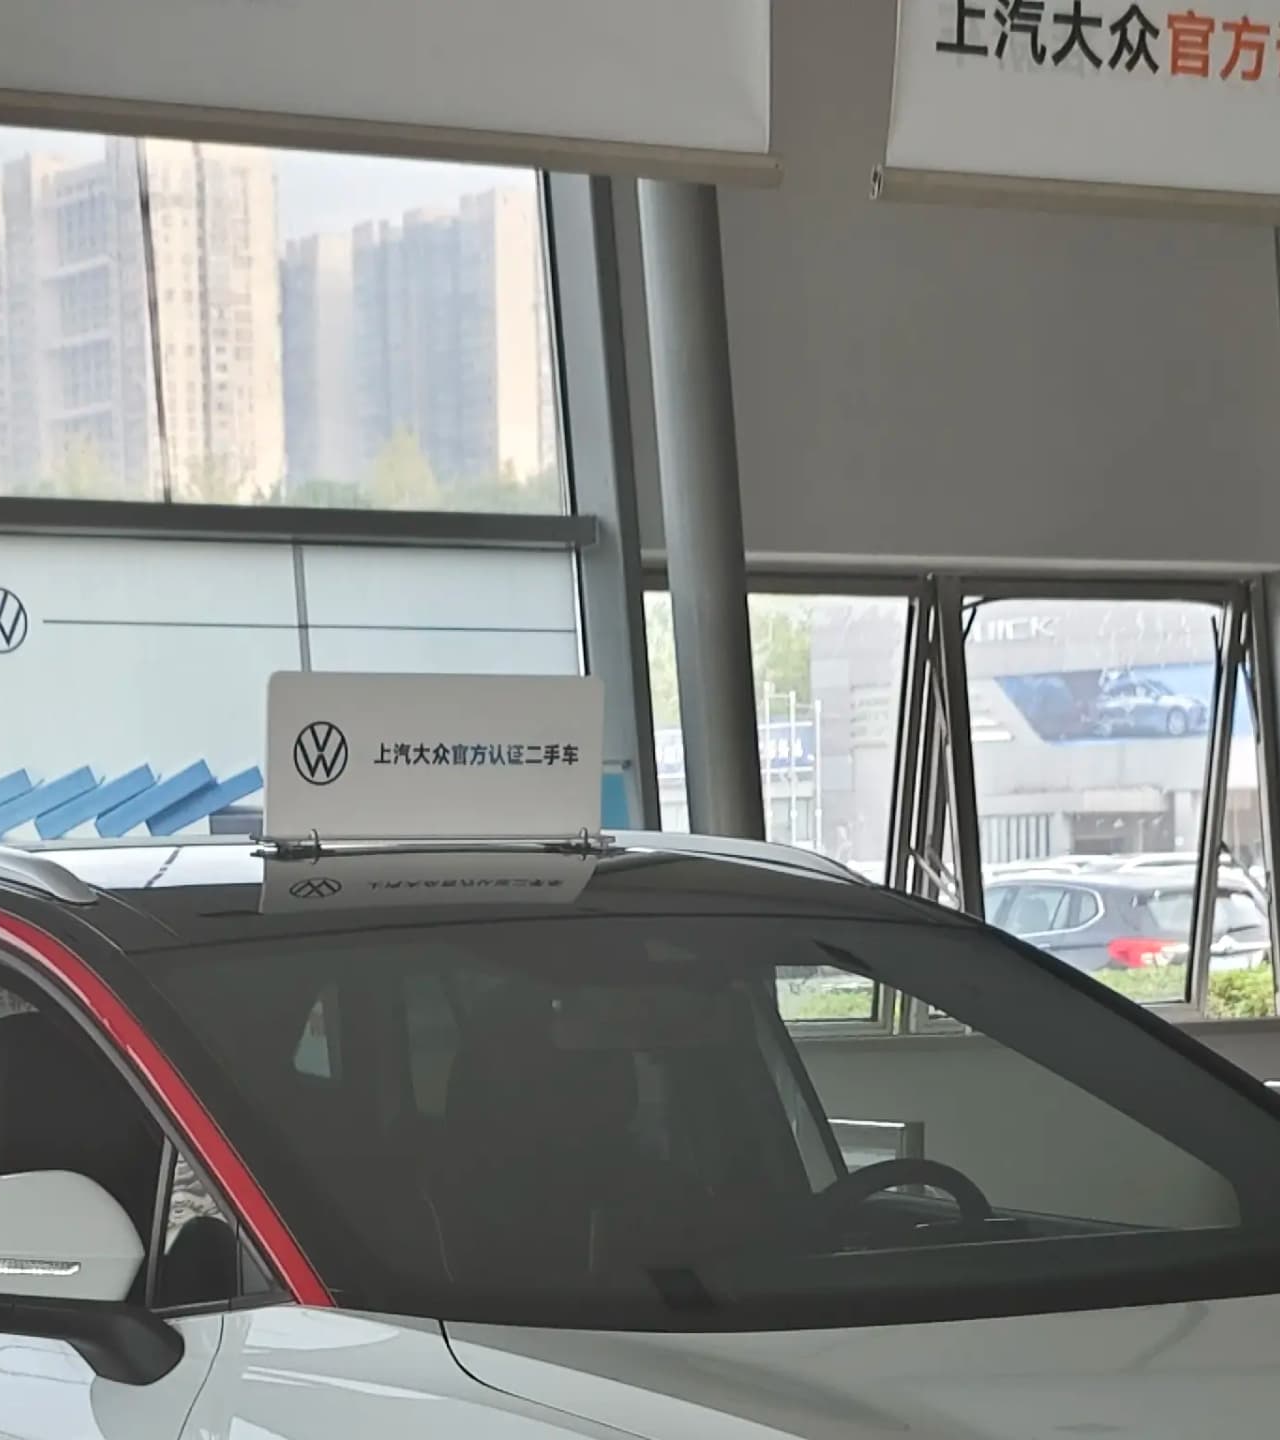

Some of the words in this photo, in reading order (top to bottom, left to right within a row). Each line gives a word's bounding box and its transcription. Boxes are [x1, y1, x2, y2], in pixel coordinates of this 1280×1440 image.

[374, 742, 579, 766] 上汽大众官方认证二手车
